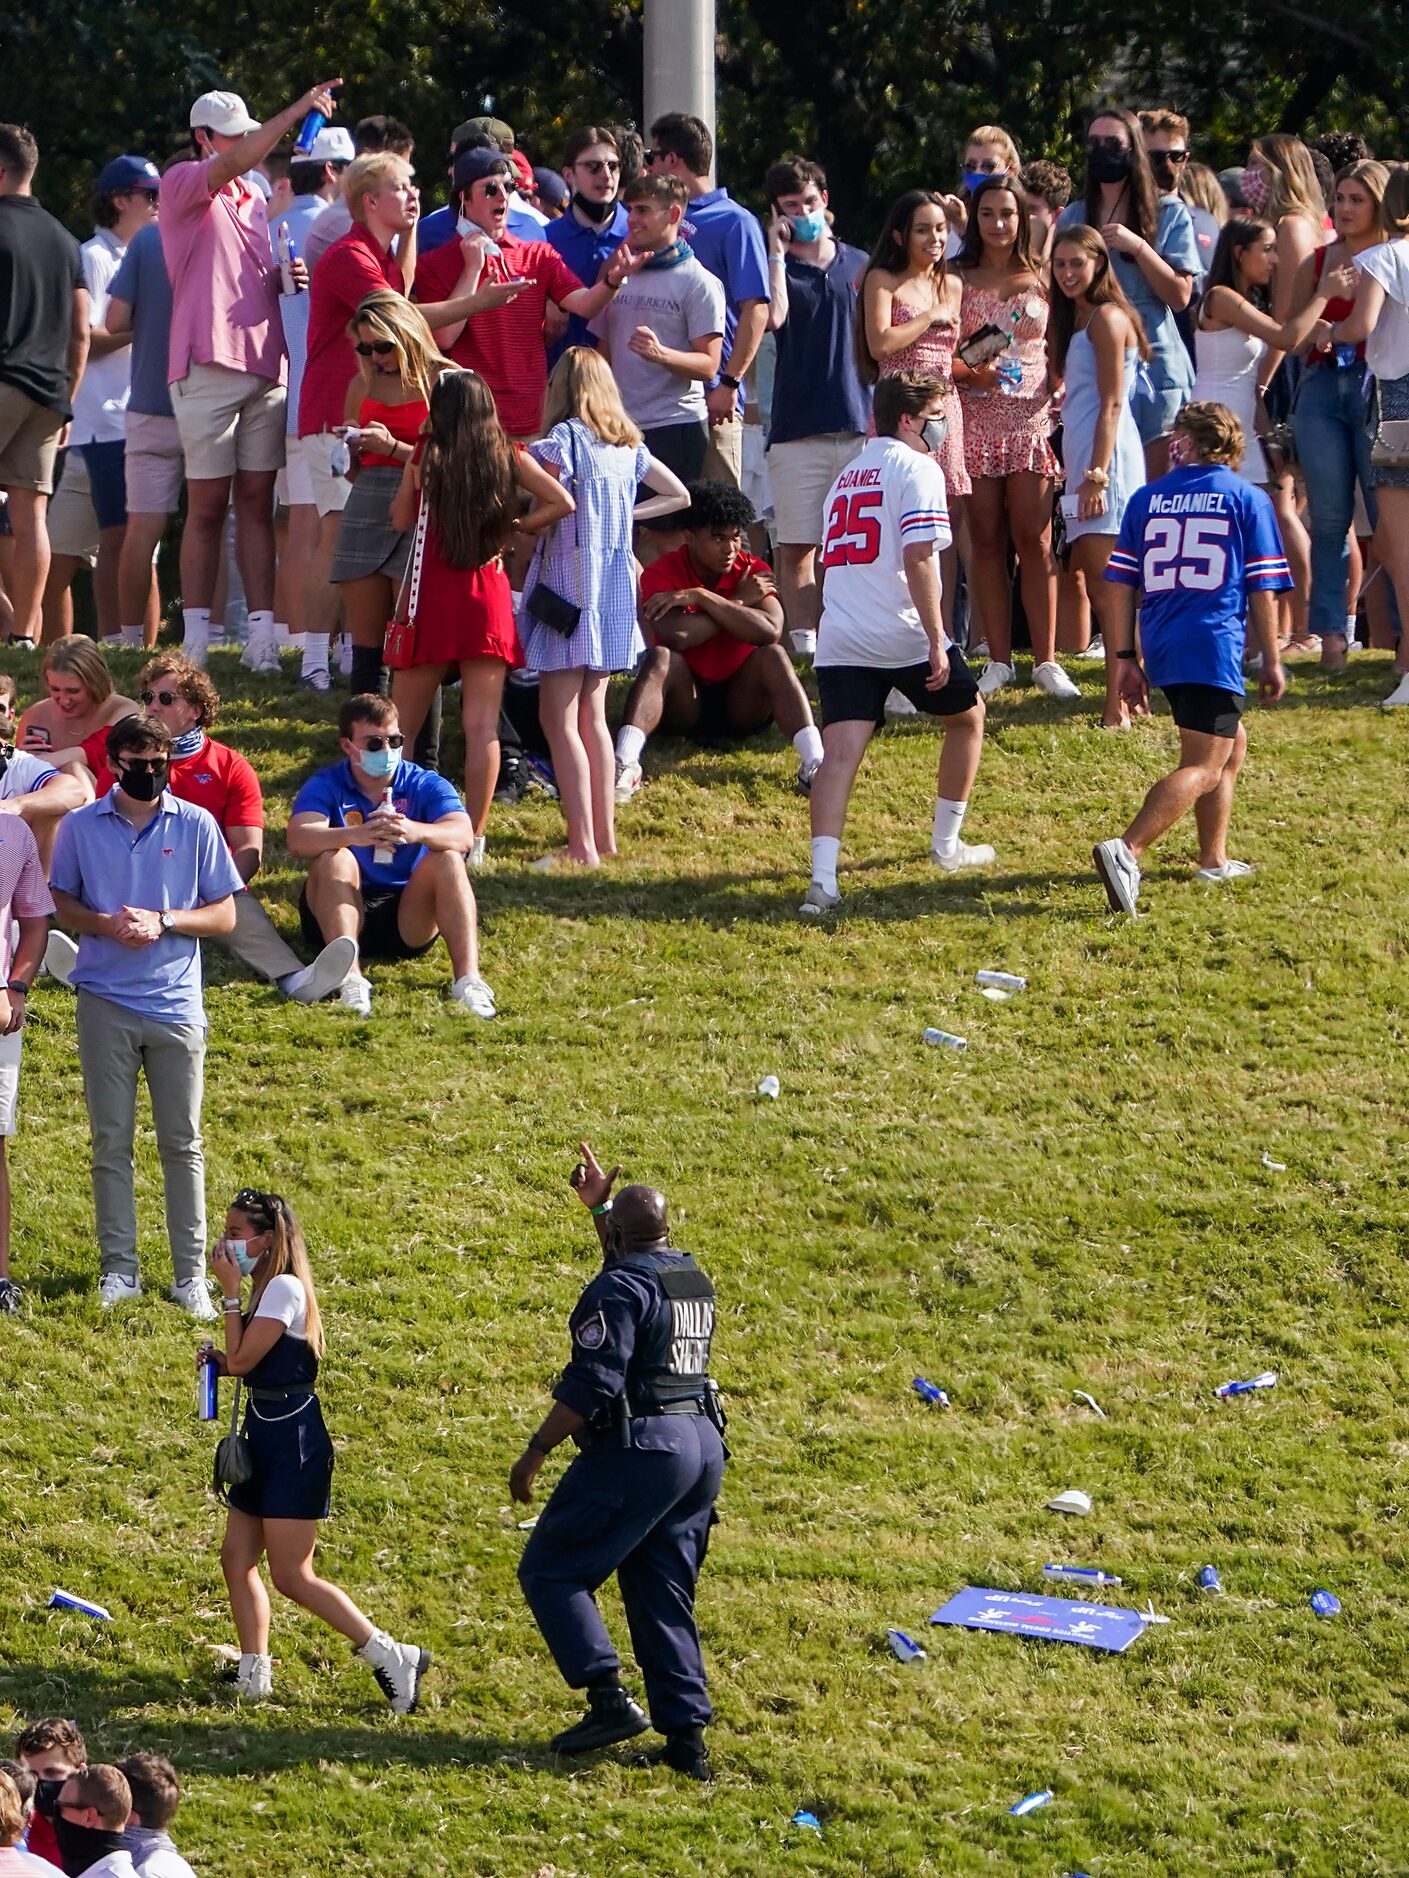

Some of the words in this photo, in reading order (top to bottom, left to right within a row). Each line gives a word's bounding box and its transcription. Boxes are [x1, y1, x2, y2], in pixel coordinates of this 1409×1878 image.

[823, 490, 883, 569] 25
[1148, 493, 1227, 514] McDANIEL
[1144, 517, 1230, 593] 25
[674, 1301, 714, 1337] DALLAS
